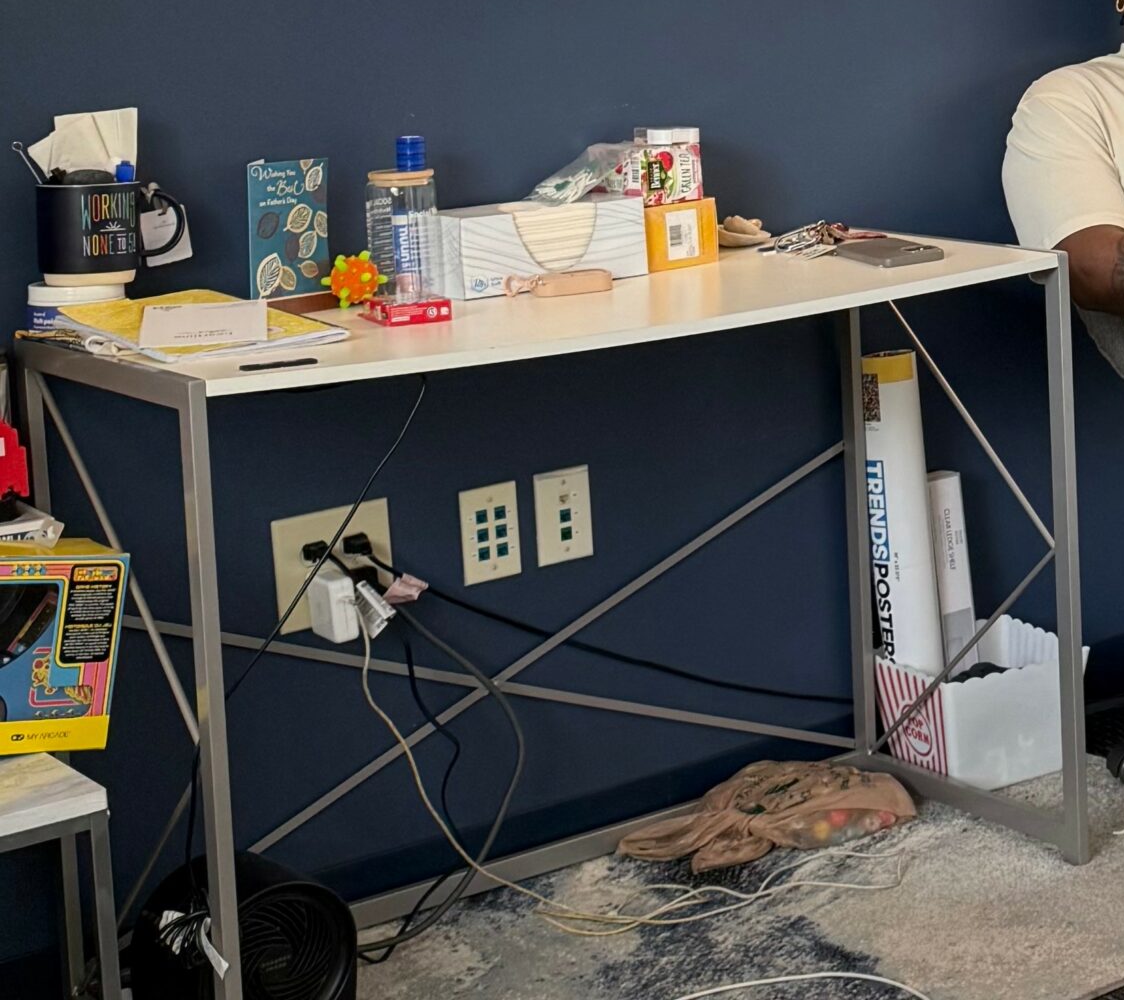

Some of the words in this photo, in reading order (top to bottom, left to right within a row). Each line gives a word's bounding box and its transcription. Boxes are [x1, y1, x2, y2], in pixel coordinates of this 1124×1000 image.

[276, 179, 305, 197] Best
[286, 196, 297, 205] Day
[81, 191, 136, 230] WORKING
[83, 234, 115, 257] NONE
[117, 237, 126, 251] TO
[909, 716, 923, 730] POP
[39, 731, 69, 739] ARCADE
